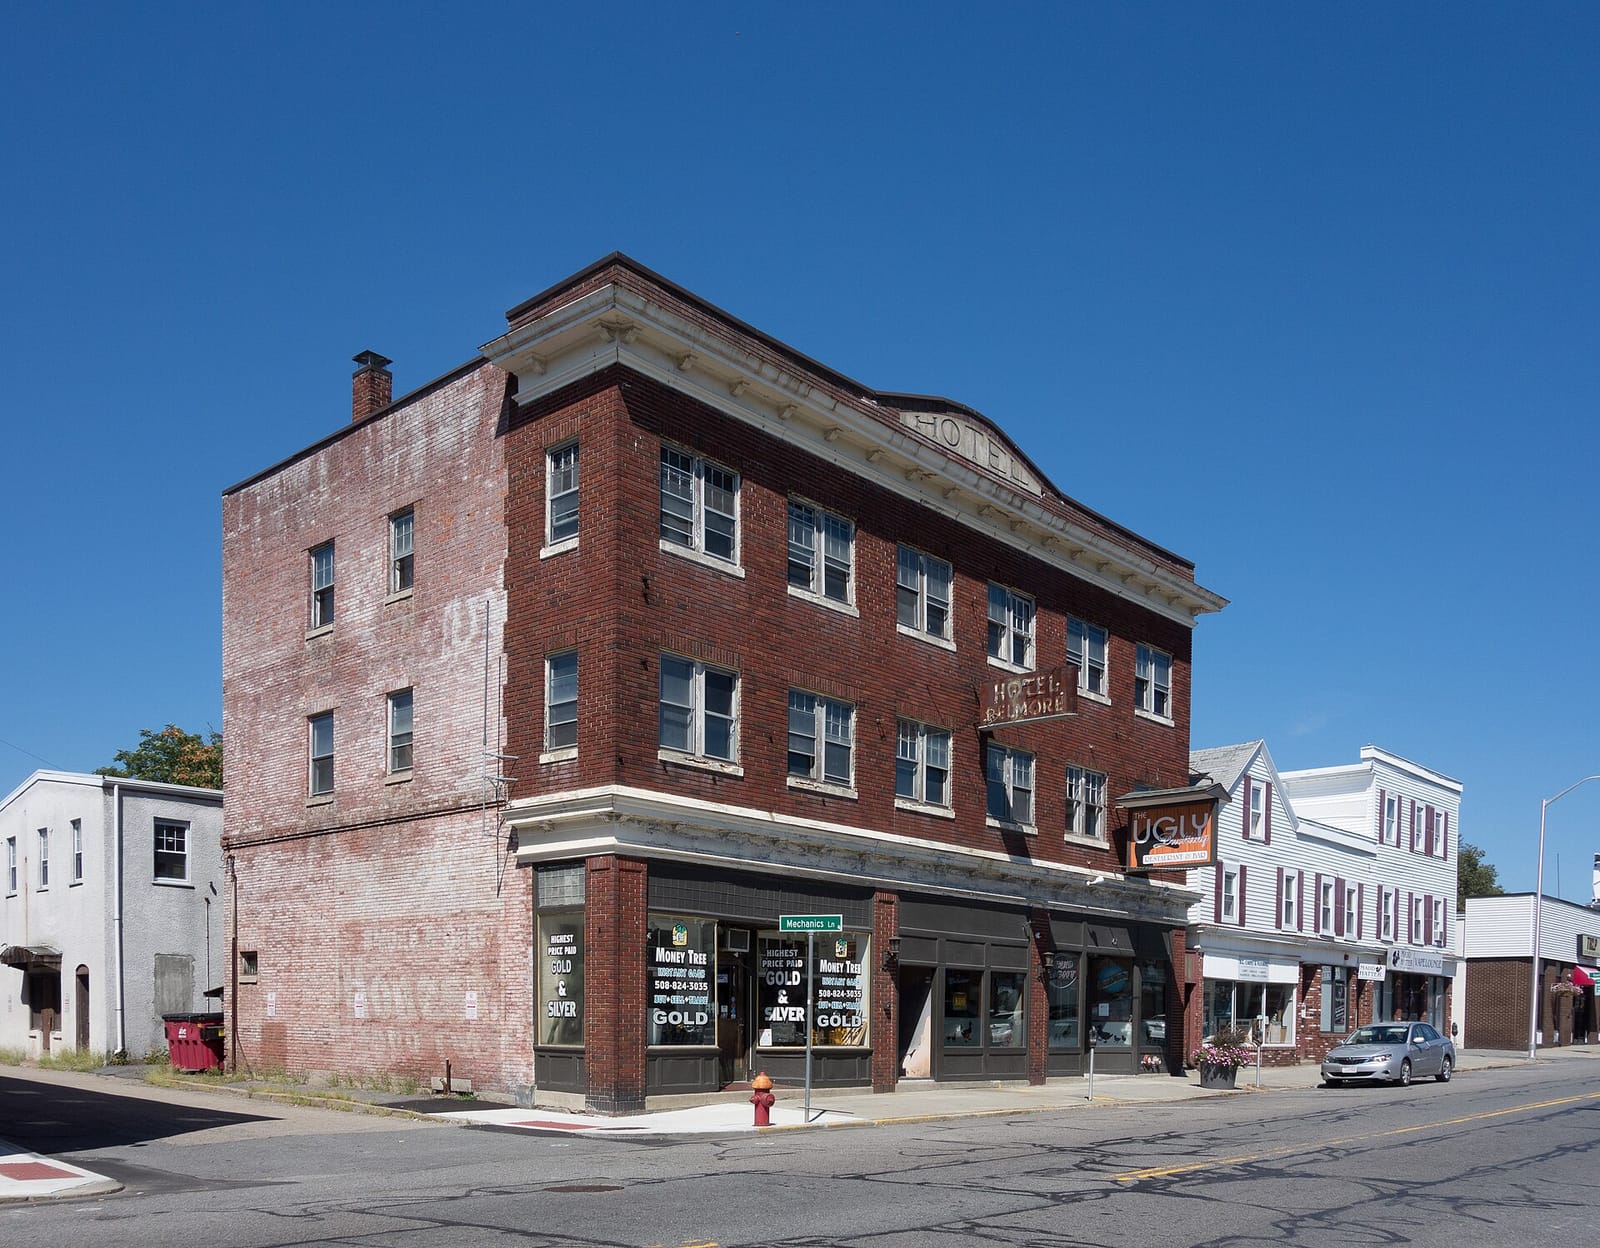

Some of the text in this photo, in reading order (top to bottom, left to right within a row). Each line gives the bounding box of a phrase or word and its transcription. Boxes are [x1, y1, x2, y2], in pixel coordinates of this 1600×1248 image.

[914, 416, 1029, 486] HOTEL
[1134, 811, 1148, 820] THE
[1133, 812, 1209, 844] UGLY
[1144, 854, 1183, 863] RESTAURANT
[1192, 851, 1206, 860] BAR
[786, 919, 824, 929] Mechanics
[550, 934, 574, 944] HIGHEST
[548, 945, 577, 956] PRICE PAID
[766, 949, 799, 957] HIGHEST
[551, 959, 572, 974] GOLD
[762, 959, 803, 968] PRICE PAID
[654, 980, 708, 991] 508-824-3035
[766, 971, 801, 986] GOLD
[558, 980, 567, 997] &
[818, 989, 862, 998] 508-824-3035
[777, 989, 789, 1005] &
[548, 1001, 577, 1018] SILVER
[764, 1006, 805, 1022] SILVER
[653, 1010, 708, 1026] GOLD
[817, 1014, 862, 1028] GOLD
